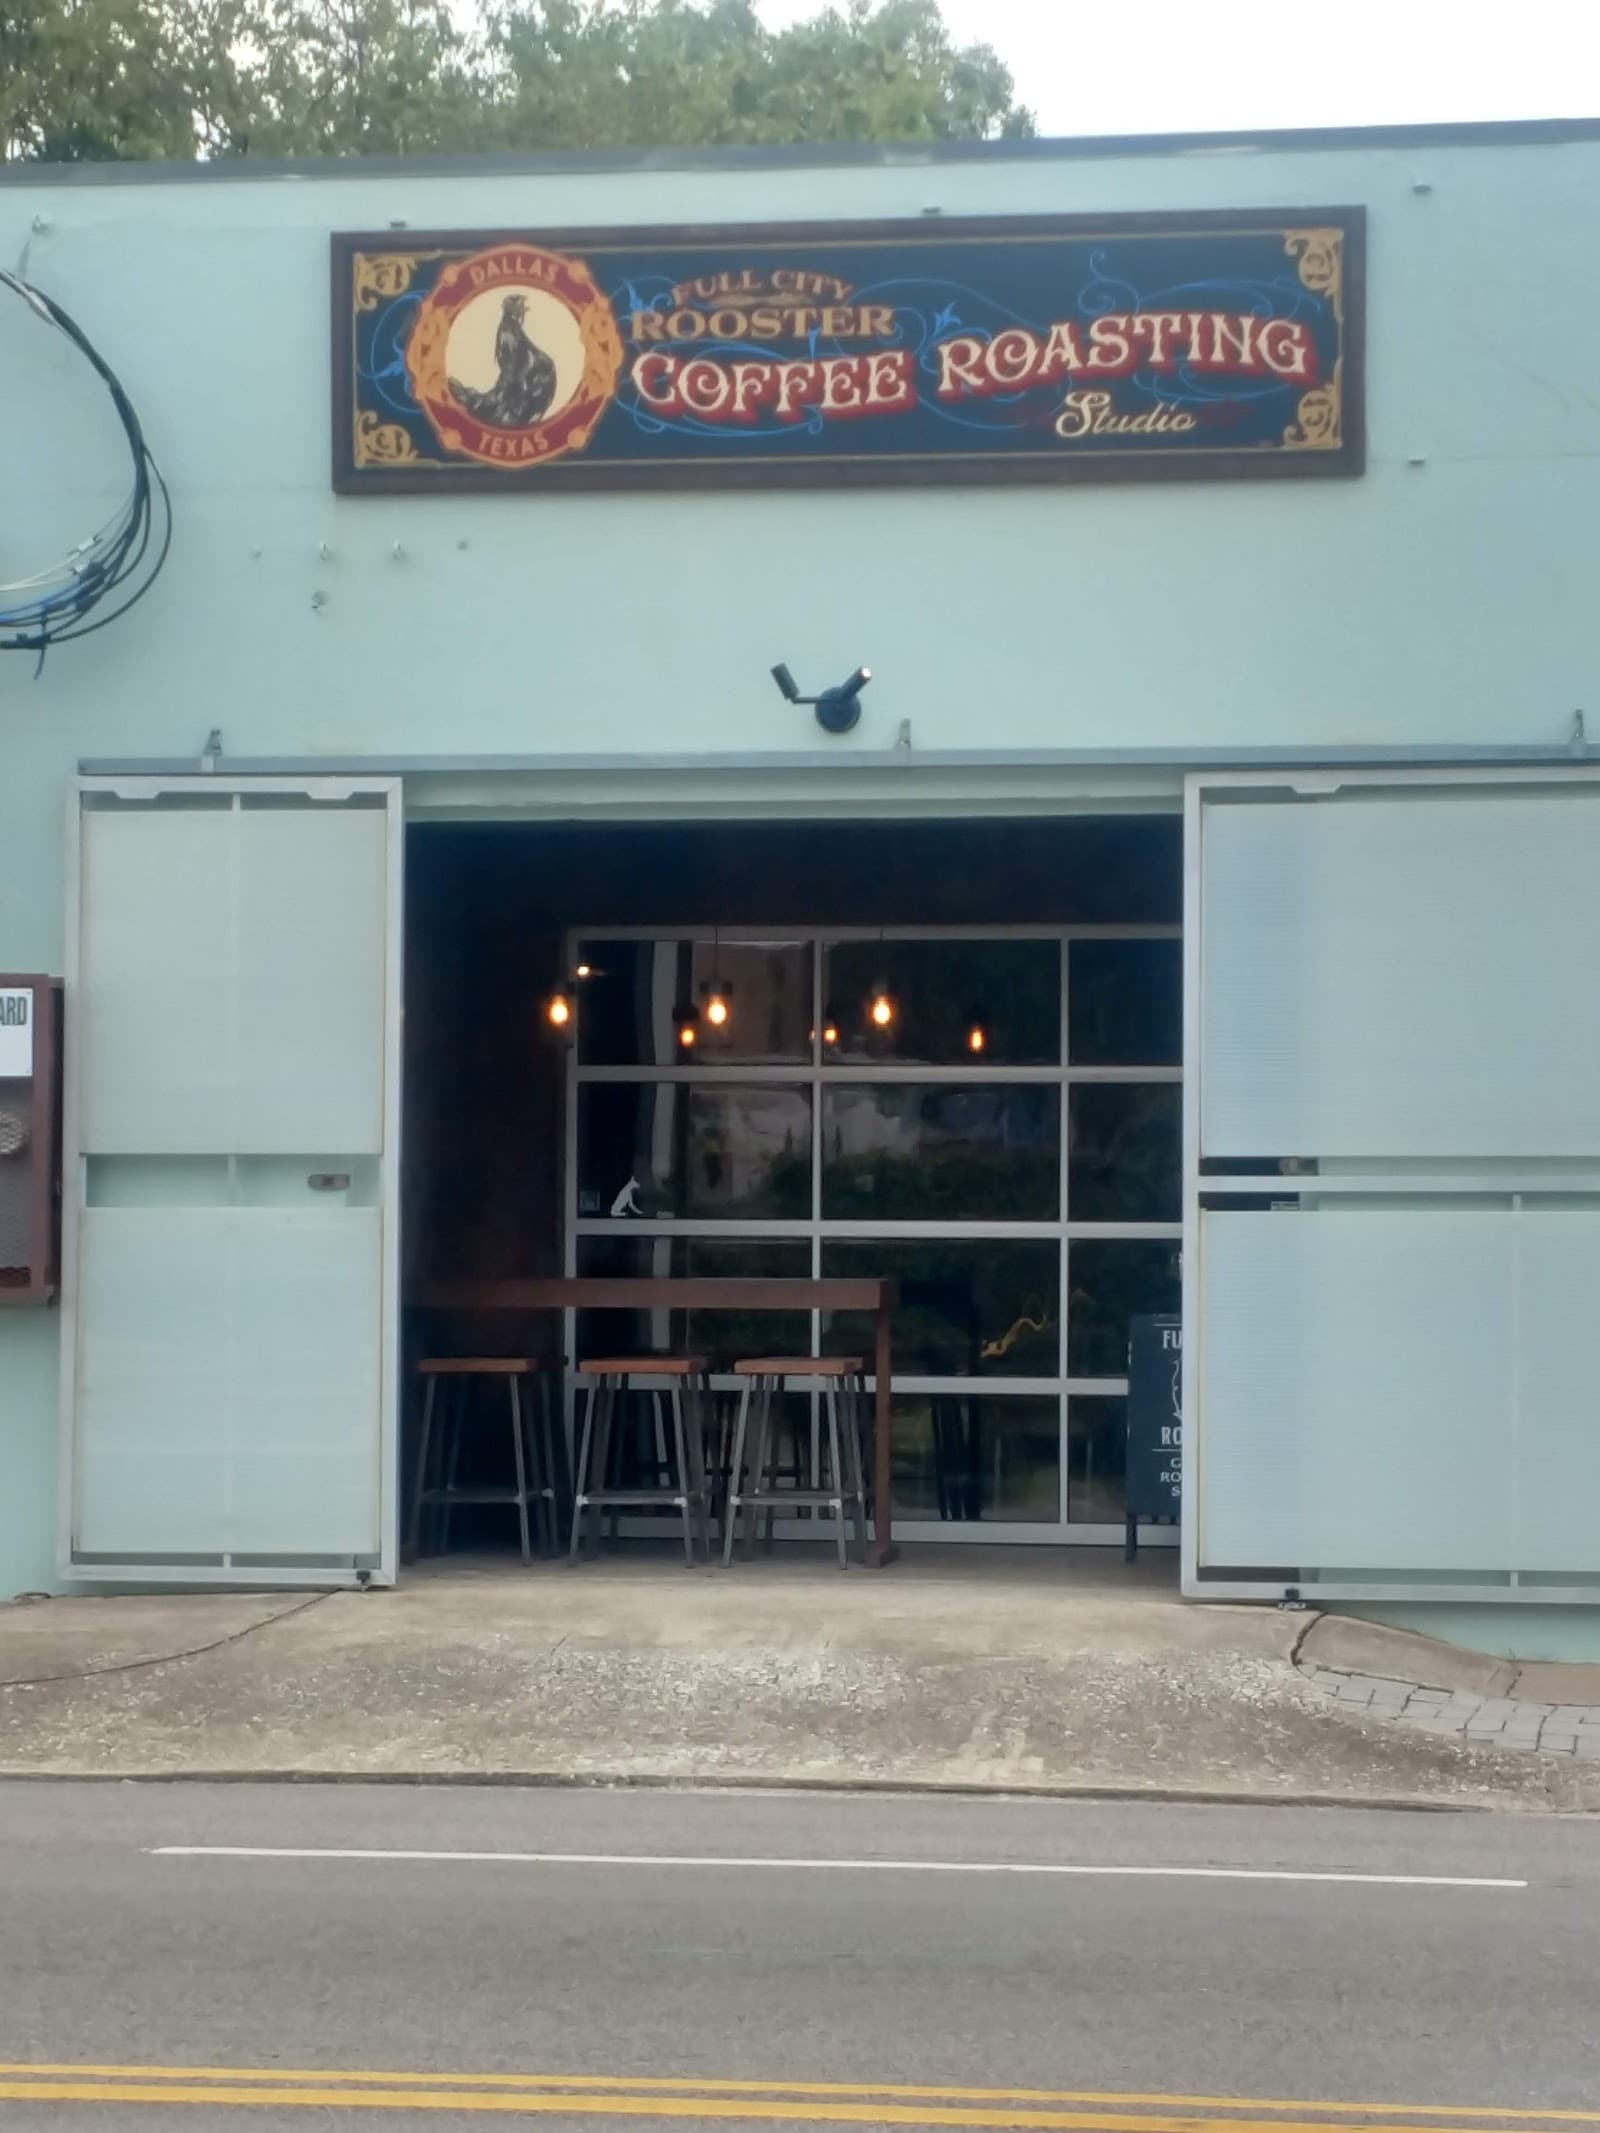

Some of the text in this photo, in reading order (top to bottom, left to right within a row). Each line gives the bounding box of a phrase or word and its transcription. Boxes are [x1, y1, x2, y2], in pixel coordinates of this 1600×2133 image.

[469, 255, 559, 284] DALLAS
[671, 269, 853, 306] FULL CITY
[631, 305, 895, 341] ROOSTER
[631, 313, 1307, 412] COFFEE ROASTING
[1055, 391, 1197, 437] Studio
[479, 430, 549, 457] TEXAS
